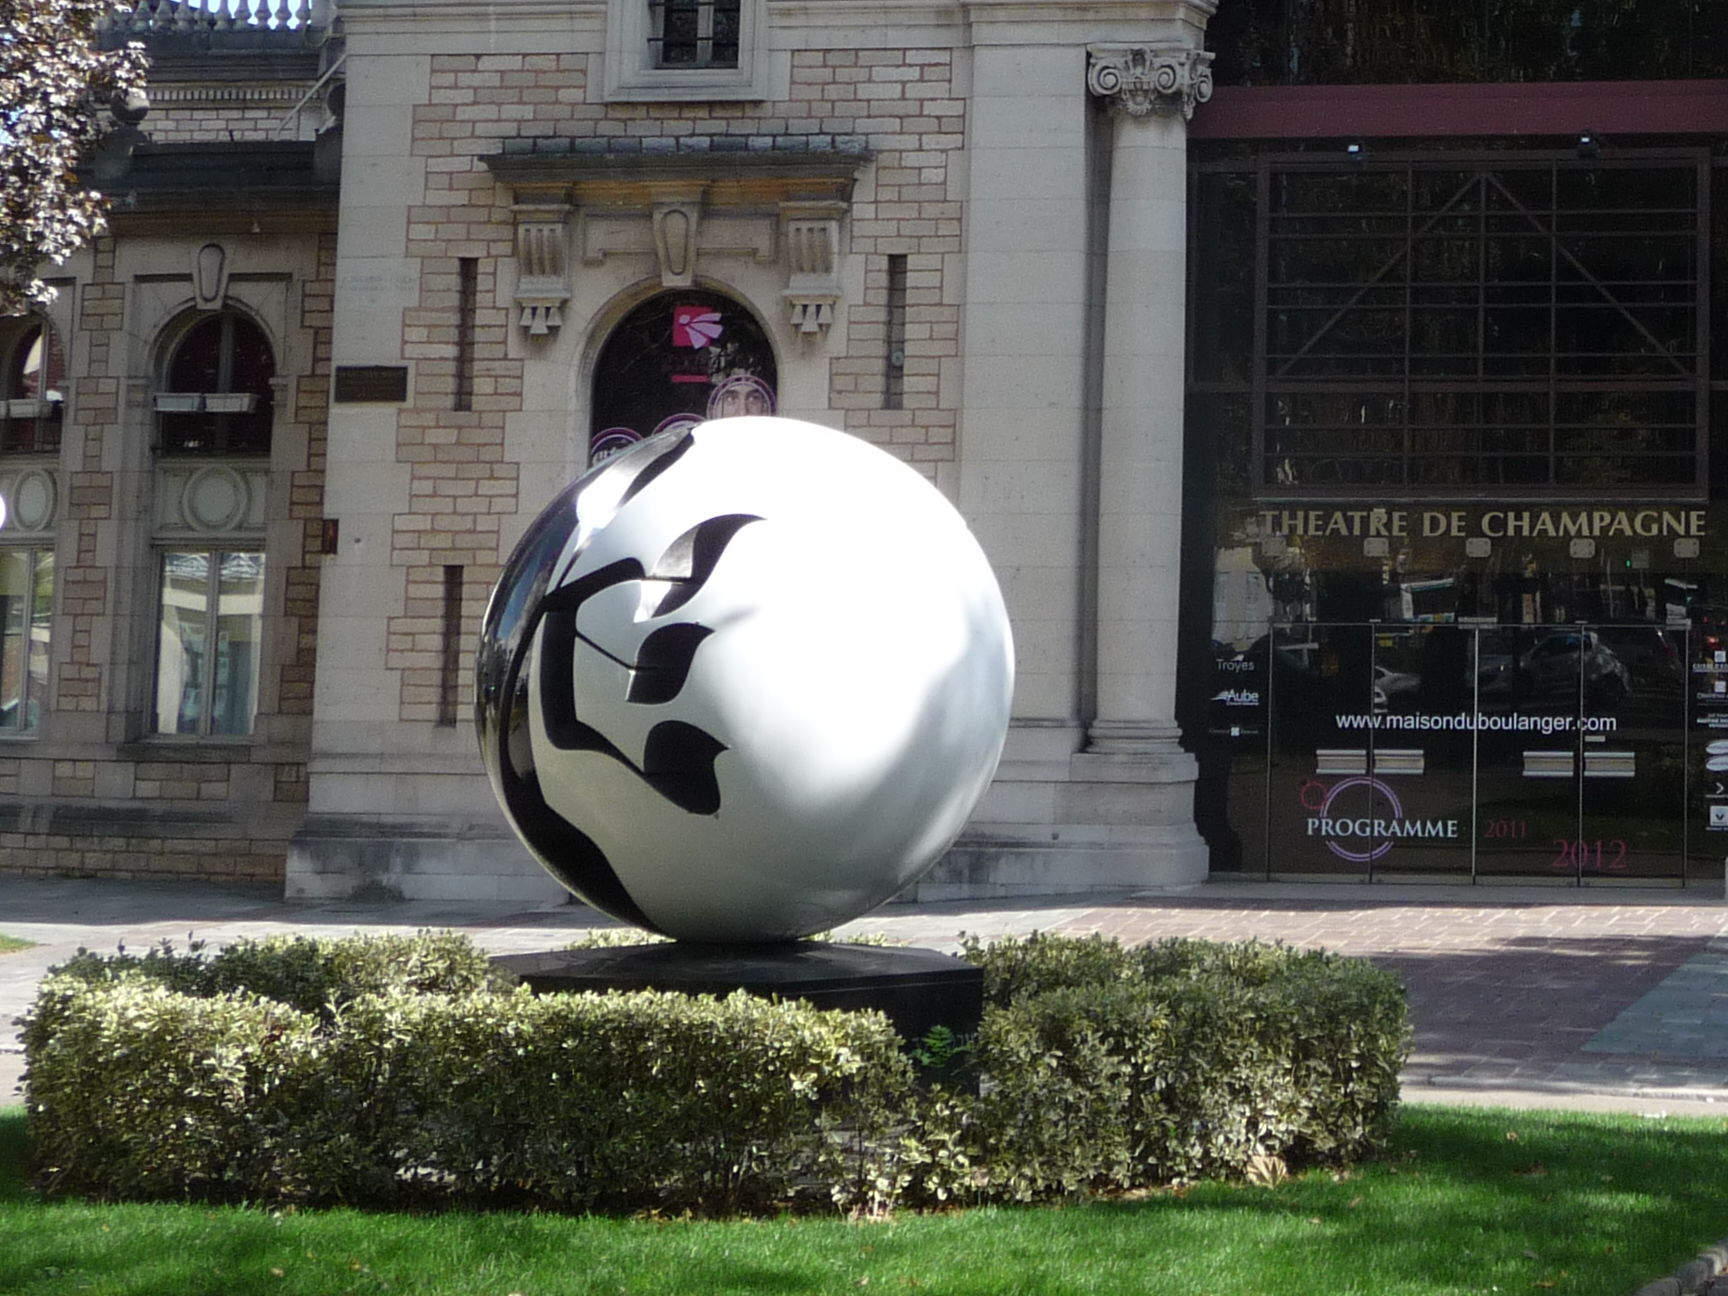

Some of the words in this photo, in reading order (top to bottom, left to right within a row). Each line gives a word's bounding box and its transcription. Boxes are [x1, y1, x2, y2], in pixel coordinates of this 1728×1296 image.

[1258, 510, 1407, 537] THEATRE
[1422, 511, 1466, 537] DE
[1481, 510, 1707, 537] CHAMPAGNE
[1216, 657, 1255, 673] Troyes
[1226, 688, 1260, 702] Aube
[1335, 712, 1617, 735] www.maisonduboulanger.com
[1305, 817, 1459, 838] PROGRAMME
[1484, 819, 1528, 839] 2011
[1551, 839, 1628, 869] 2012
